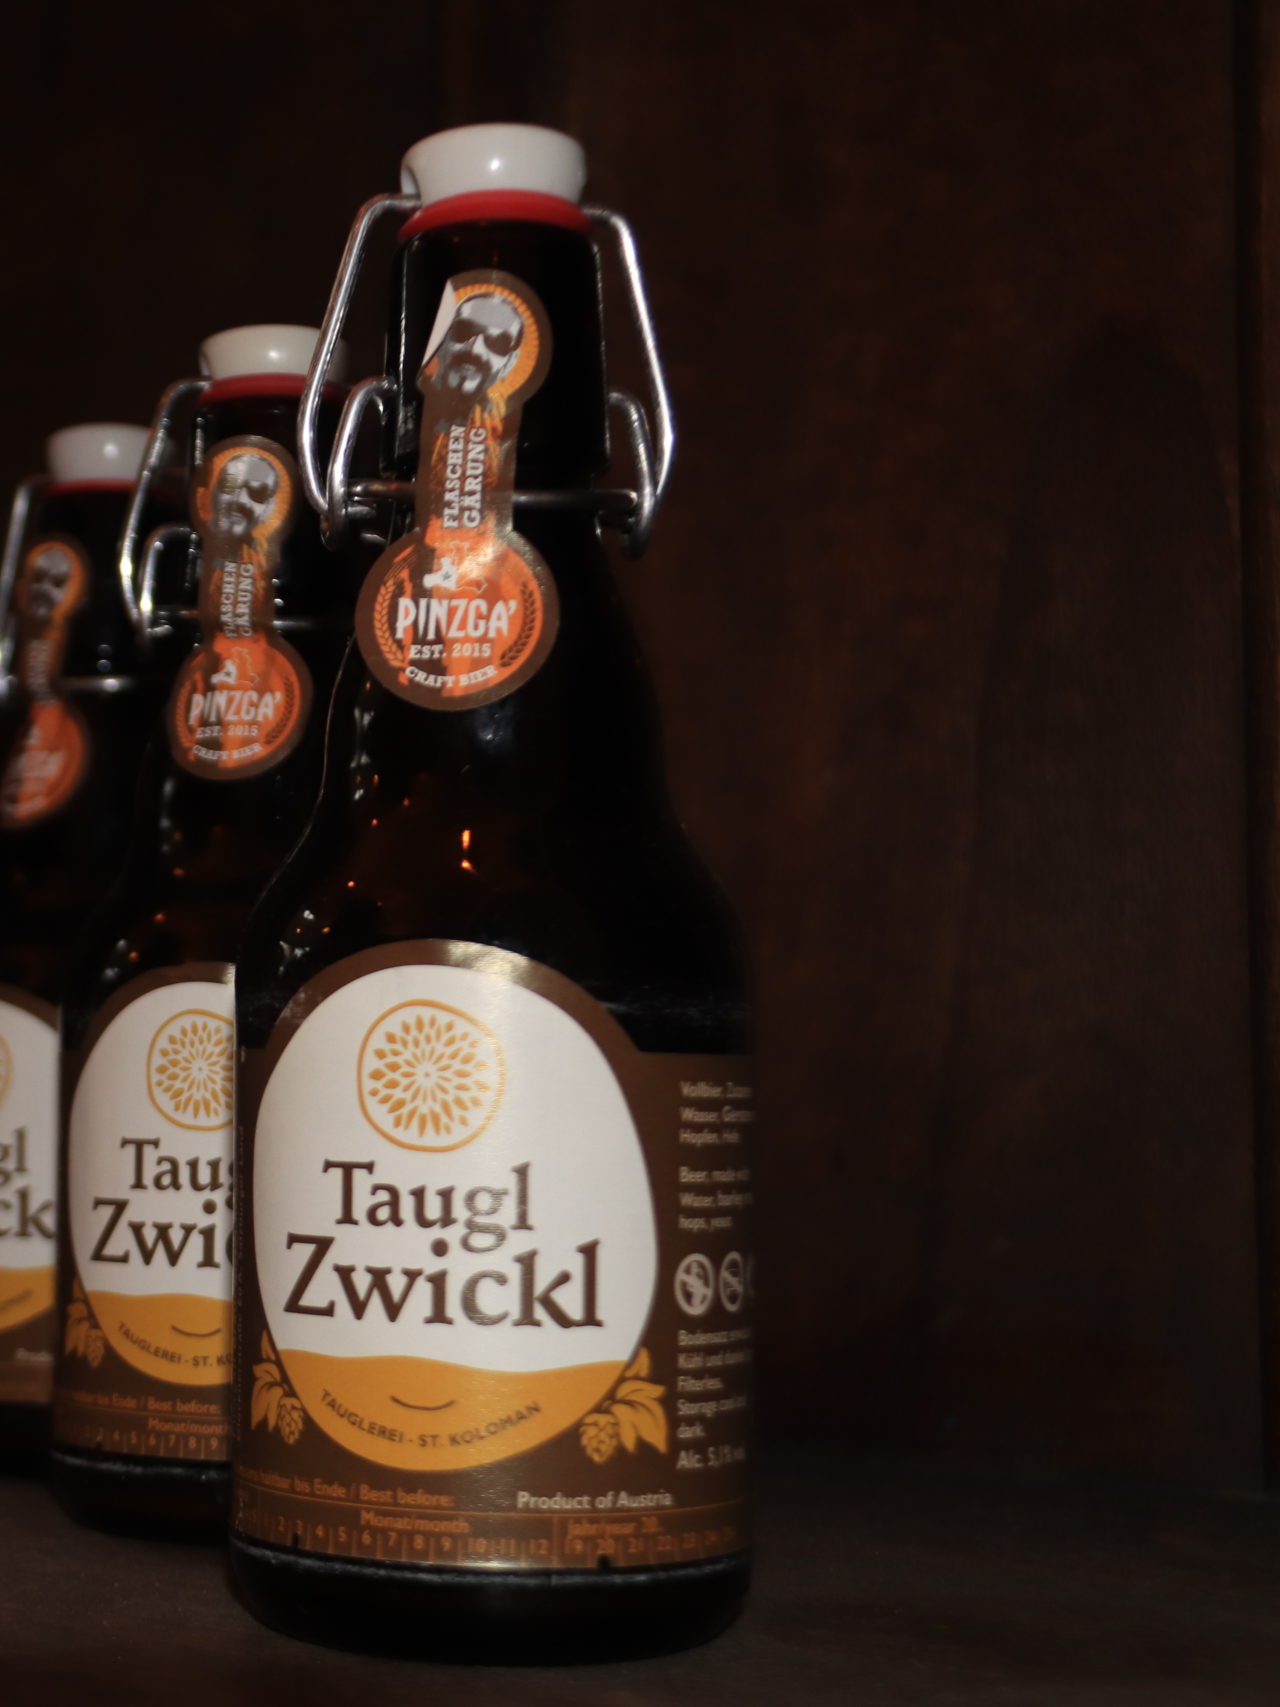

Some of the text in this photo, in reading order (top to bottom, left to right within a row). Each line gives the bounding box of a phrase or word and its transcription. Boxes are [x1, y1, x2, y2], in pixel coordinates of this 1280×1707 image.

[443, 424, 466, 529] FLASCHEN
[410, 642, 492, 660] EST. 2015
[405, 665, 498, 688] CRAFT BIER
[196, 724, 259, 738] EST. 2015
[121, 1136, 234, 1210] Tau
[322, 1159, 534, 1254] Taugl
[90, 1197, 234, 1269] Zwi
[282, 1232, 605, 1329] Zwickl
[118, 1320, 183, 1364] TAUGLEREI
[320, 1388, 404, 1444] TAUGLEREI
[418, 1434, 441, 1448] ST.
[449, 1399, 543, 1448] KOLOMAN
[313, 1478, 346, 1498] Ende
[359, 1483, 393, 1503] Best
[397, 1487, 456, 1507] before:
[517, 1489, 674, 1509] Product of Austria
[336, 1526, 347, 1542] 5
[361, 1530, 371, 1545] 6
[387, 1531, 398, 1547] 7
[413, 1534, 424, 1550] 8
[440, 1536, 452, 1552] 9
[467, 1537, 487, 1553] 10
